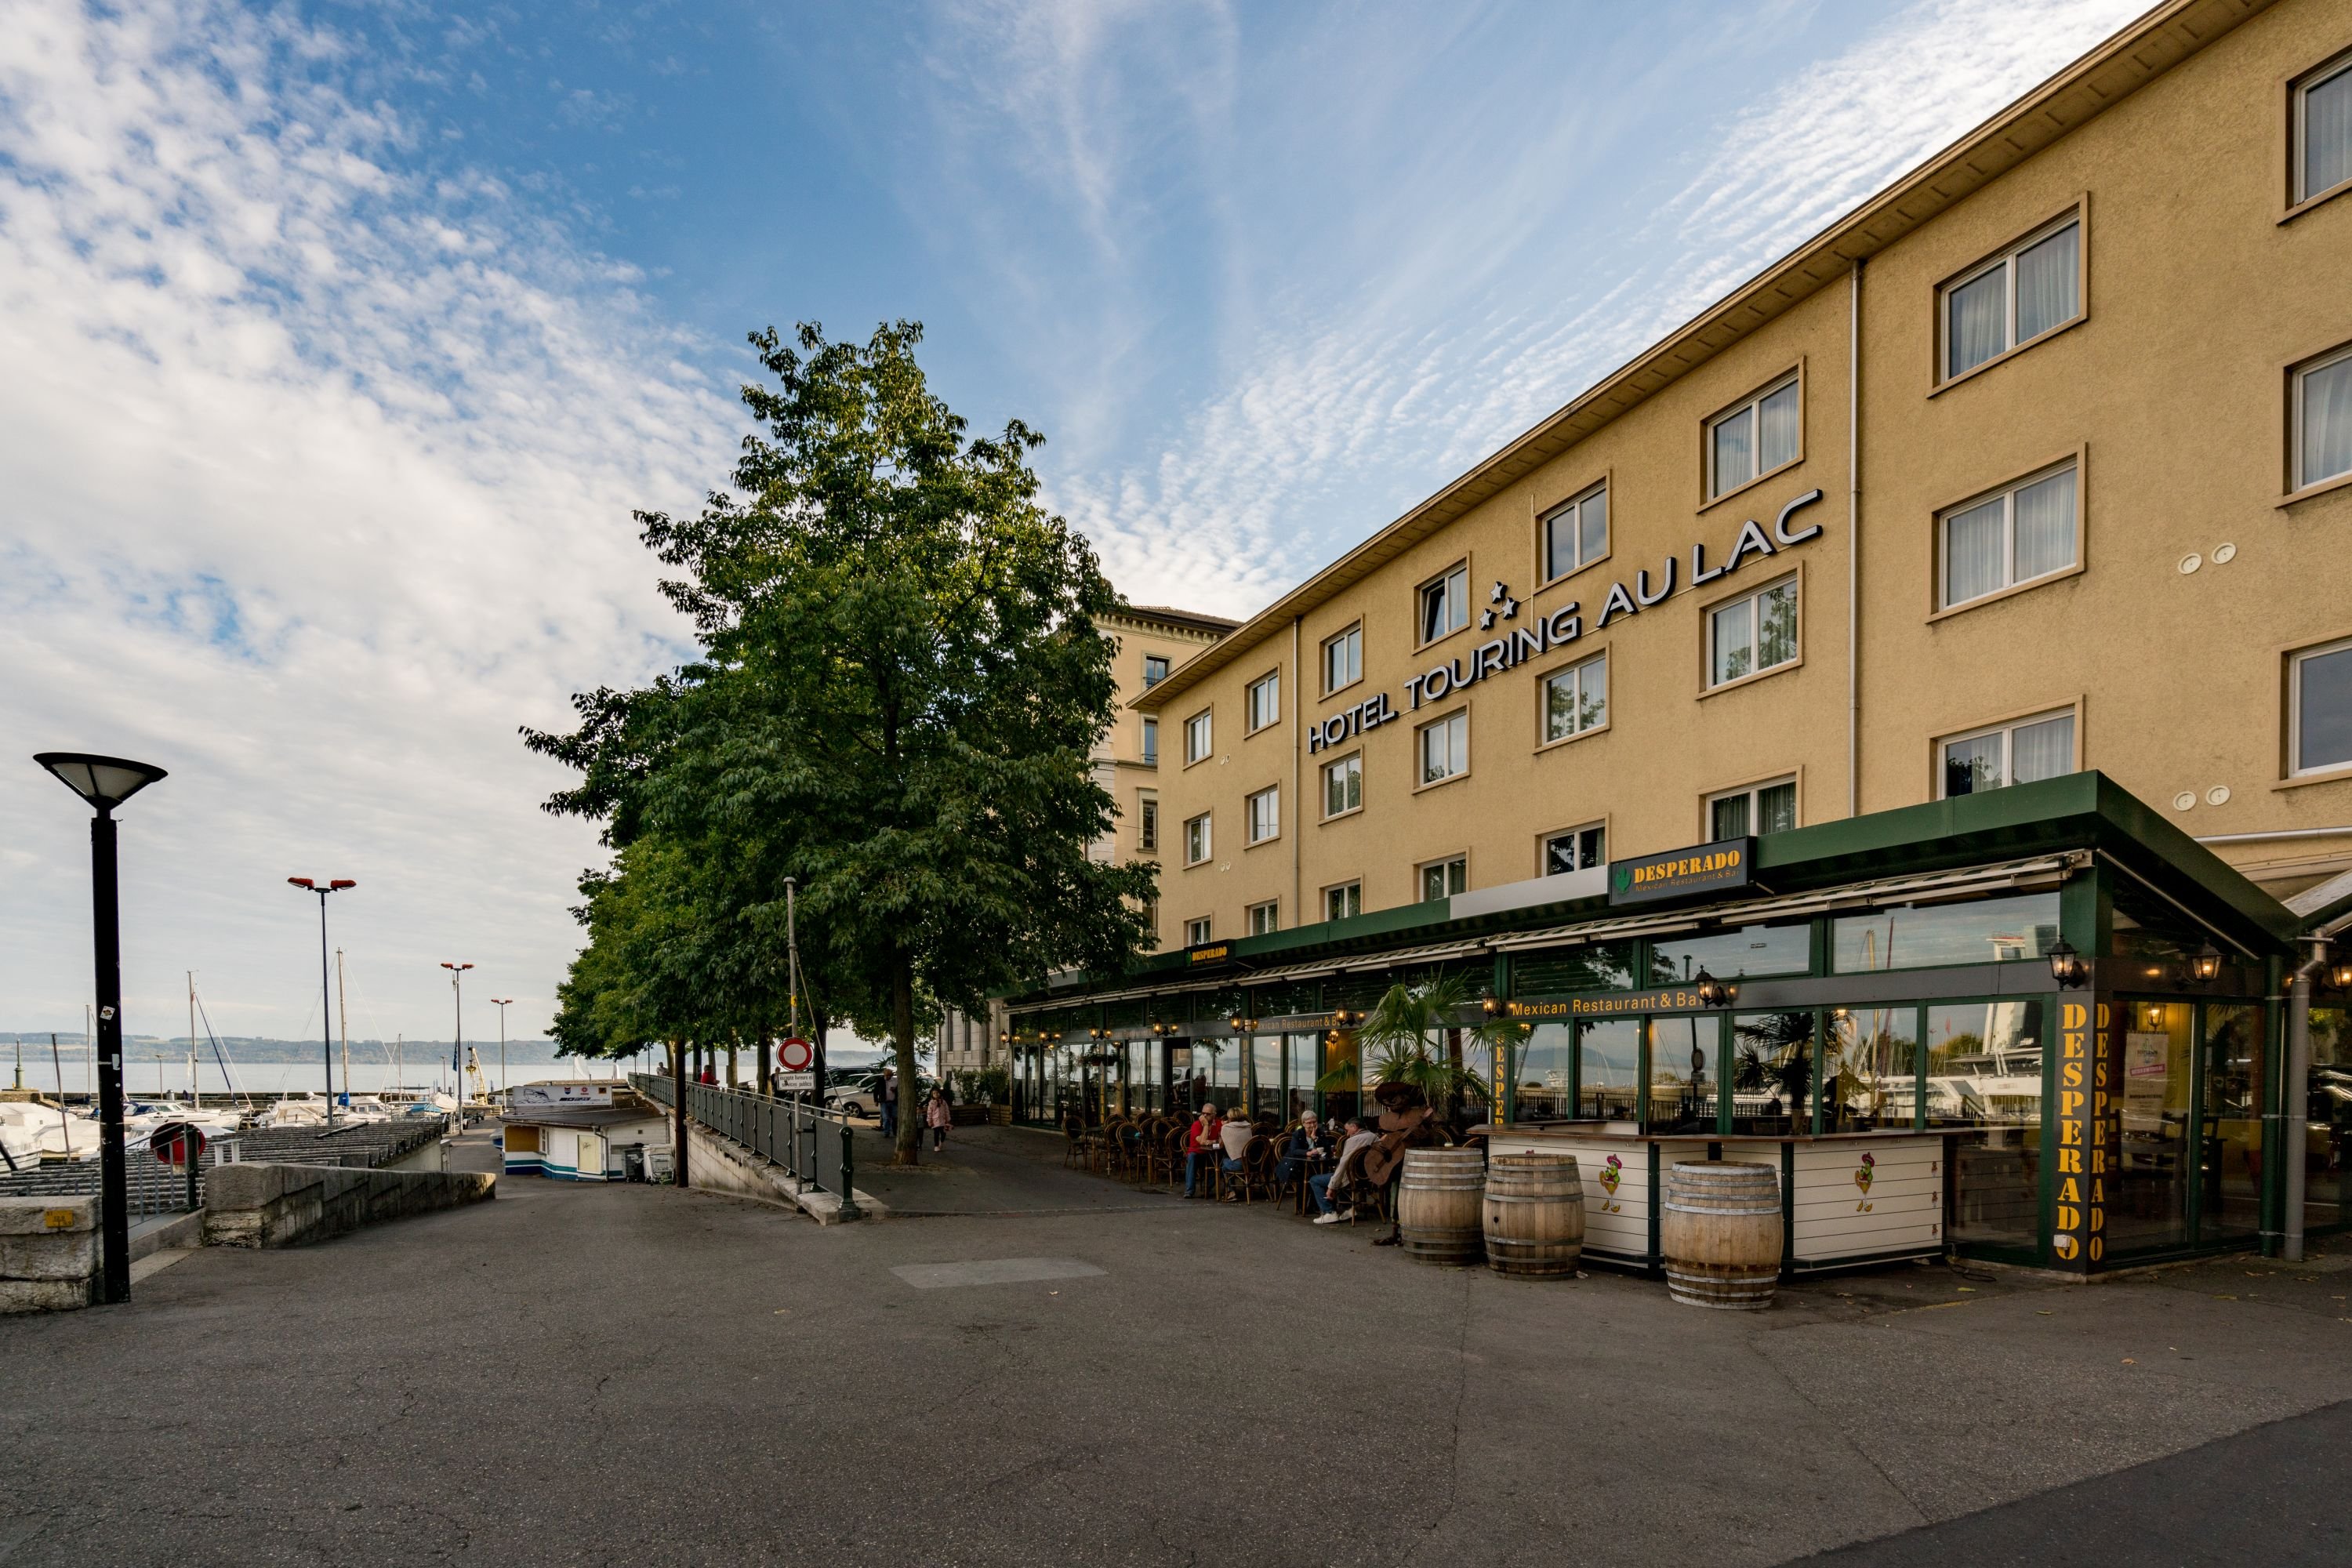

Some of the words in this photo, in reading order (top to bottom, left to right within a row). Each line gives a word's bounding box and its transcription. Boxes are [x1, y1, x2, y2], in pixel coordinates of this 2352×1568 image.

[1308, 692, 1399, 753] HOTEL
[1404, 601, 1582, 710] TOURING
[1596, 557, 1677, 628] AU
[1692, 488, 1823, 586] LAC
[1634, 850, 1741, 884] DESPERADO
[1635, 883, 1668, 892] Mexican
[1671, 873, 1715, 886] Restaurant
[1192, 946, 1228, 962] DESPERADO
[1512, 1002, 1566, 1016] Mexican
[1573, 995, 1656, 1013] Restaurant
[1660, 993, 1671, 1008] &
[1282, 1017, 1323, 1029] Restaurant
[1324, 1016, 1330, 1026] &
[2056, 1004, 2087, 1260] DESPERADO
[2089, 1003, 2110, 1261] DESPERADO
